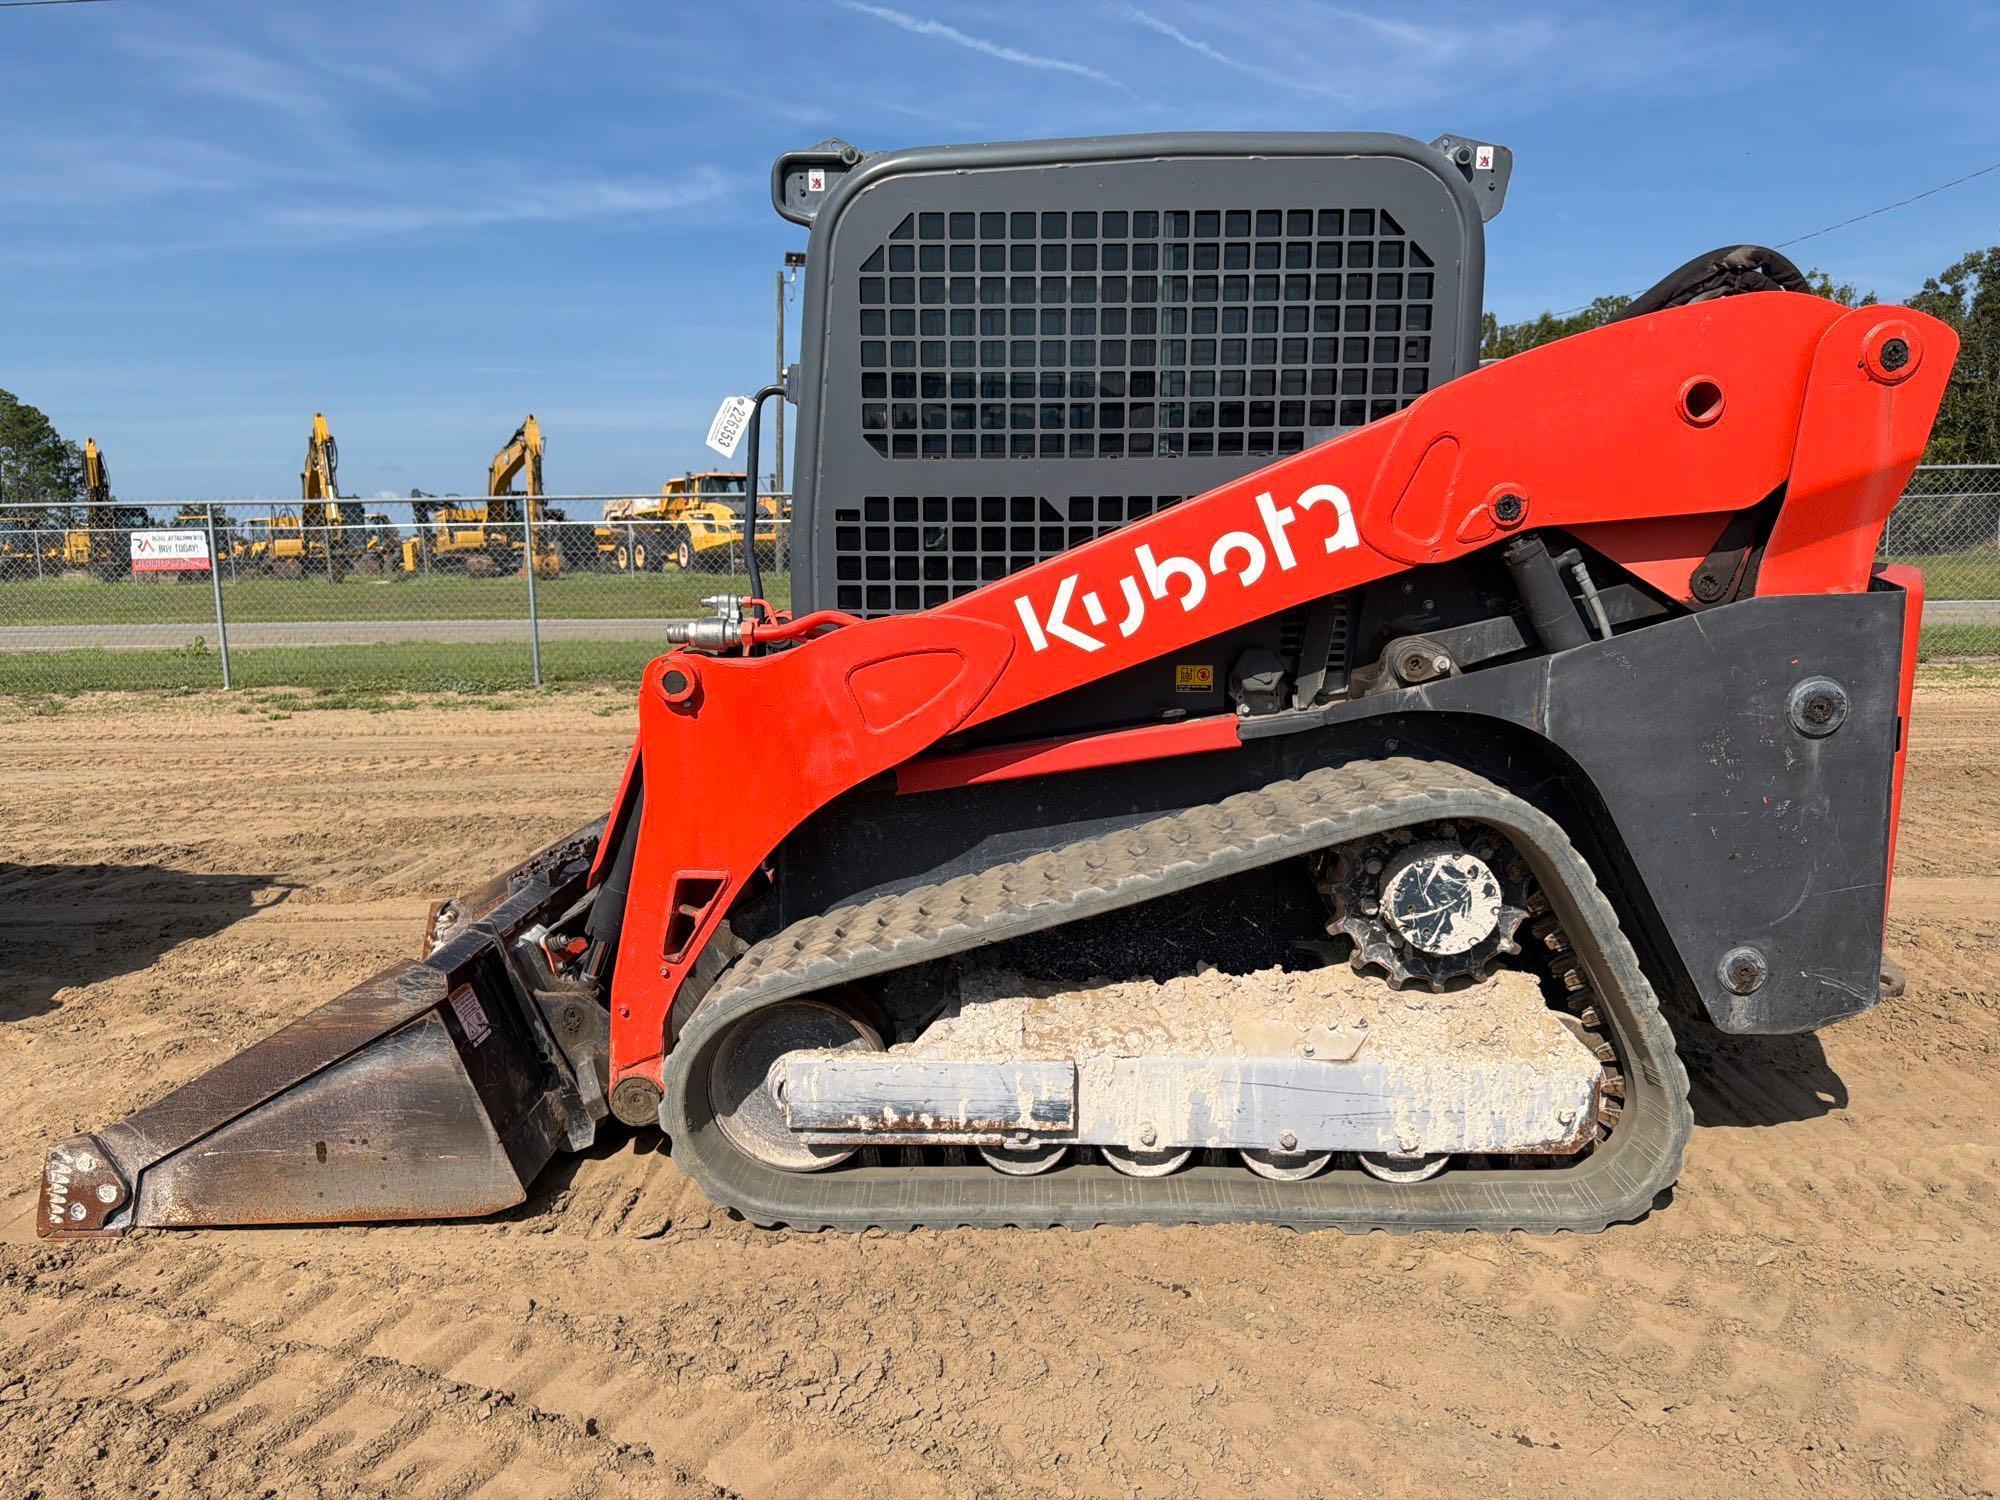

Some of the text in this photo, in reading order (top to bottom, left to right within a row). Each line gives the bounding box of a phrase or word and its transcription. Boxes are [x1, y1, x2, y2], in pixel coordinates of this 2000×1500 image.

[718, 406, 746, 448] 226353
[158, 543, 199, 553] BUY TODAY!
[1013, 484, 1360, 653] Kubota
